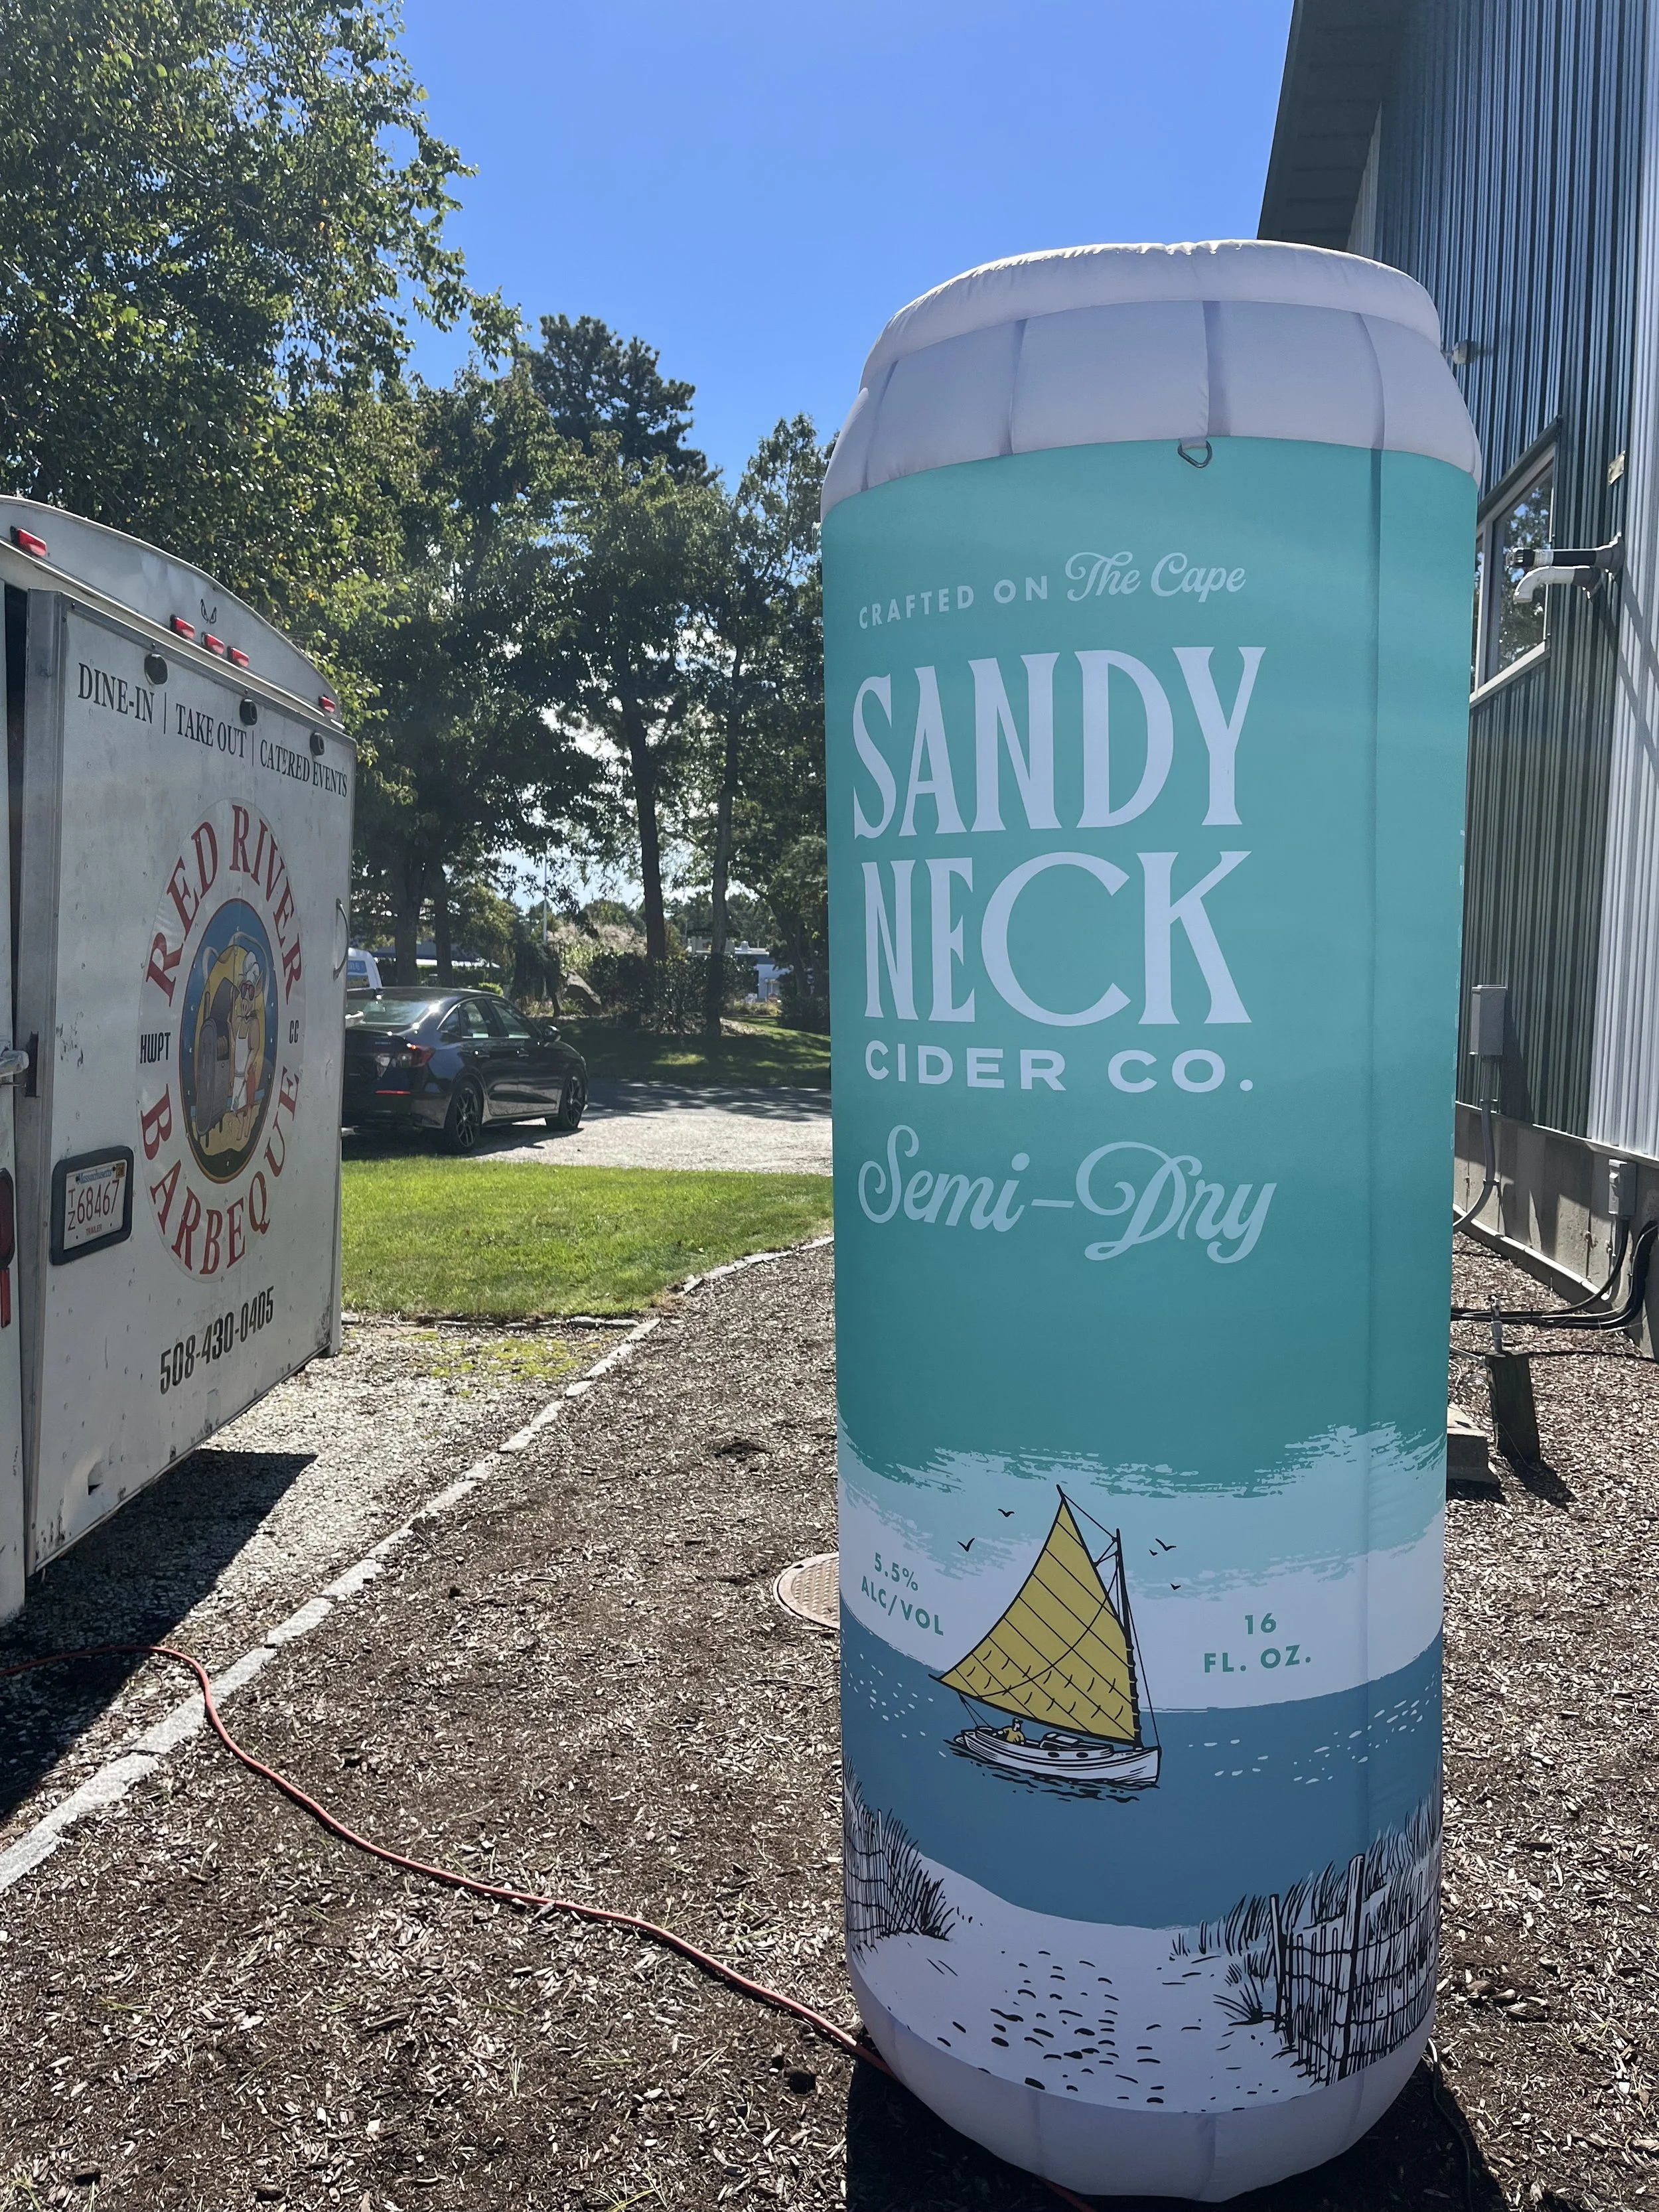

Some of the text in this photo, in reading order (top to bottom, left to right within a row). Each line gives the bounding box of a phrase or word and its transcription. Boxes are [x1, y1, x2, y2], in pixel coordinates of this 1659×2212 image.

[859, 551, 1246, 630] CRAFTED ON The Cape
[78, 662, 347, 798] DINE-IN TAKE OUT CATERED EVENTS
[853, 646, 1267, 840] SANDY
[145, 804, 301, 1007] RED RIVER
[861, 851, 1252, 1027] NECK
[140, 1032, 171, 1064] HWPT
[289, 1019, 299, 1044] CC
[864, 1040, 1254, 1093] CIDER CO.
[141, 1066, 299, 1275] BARBEQUE
[857, 1124, 1276, 1264] Semi-Dry
[77, 1179, 119, 1224] 68467
[86, 1224, 102, 1236] TRAILER
[160, 1286, 273, 1394] 508-430-0405
[875, 1552, 918, 1591] 5.5%
[861, 1575, 944, 1636] ALC/VOL
[1245, 1613, 1276, 1634] 16
[1204, 1645, 1311, 1672] FL. OZ.
